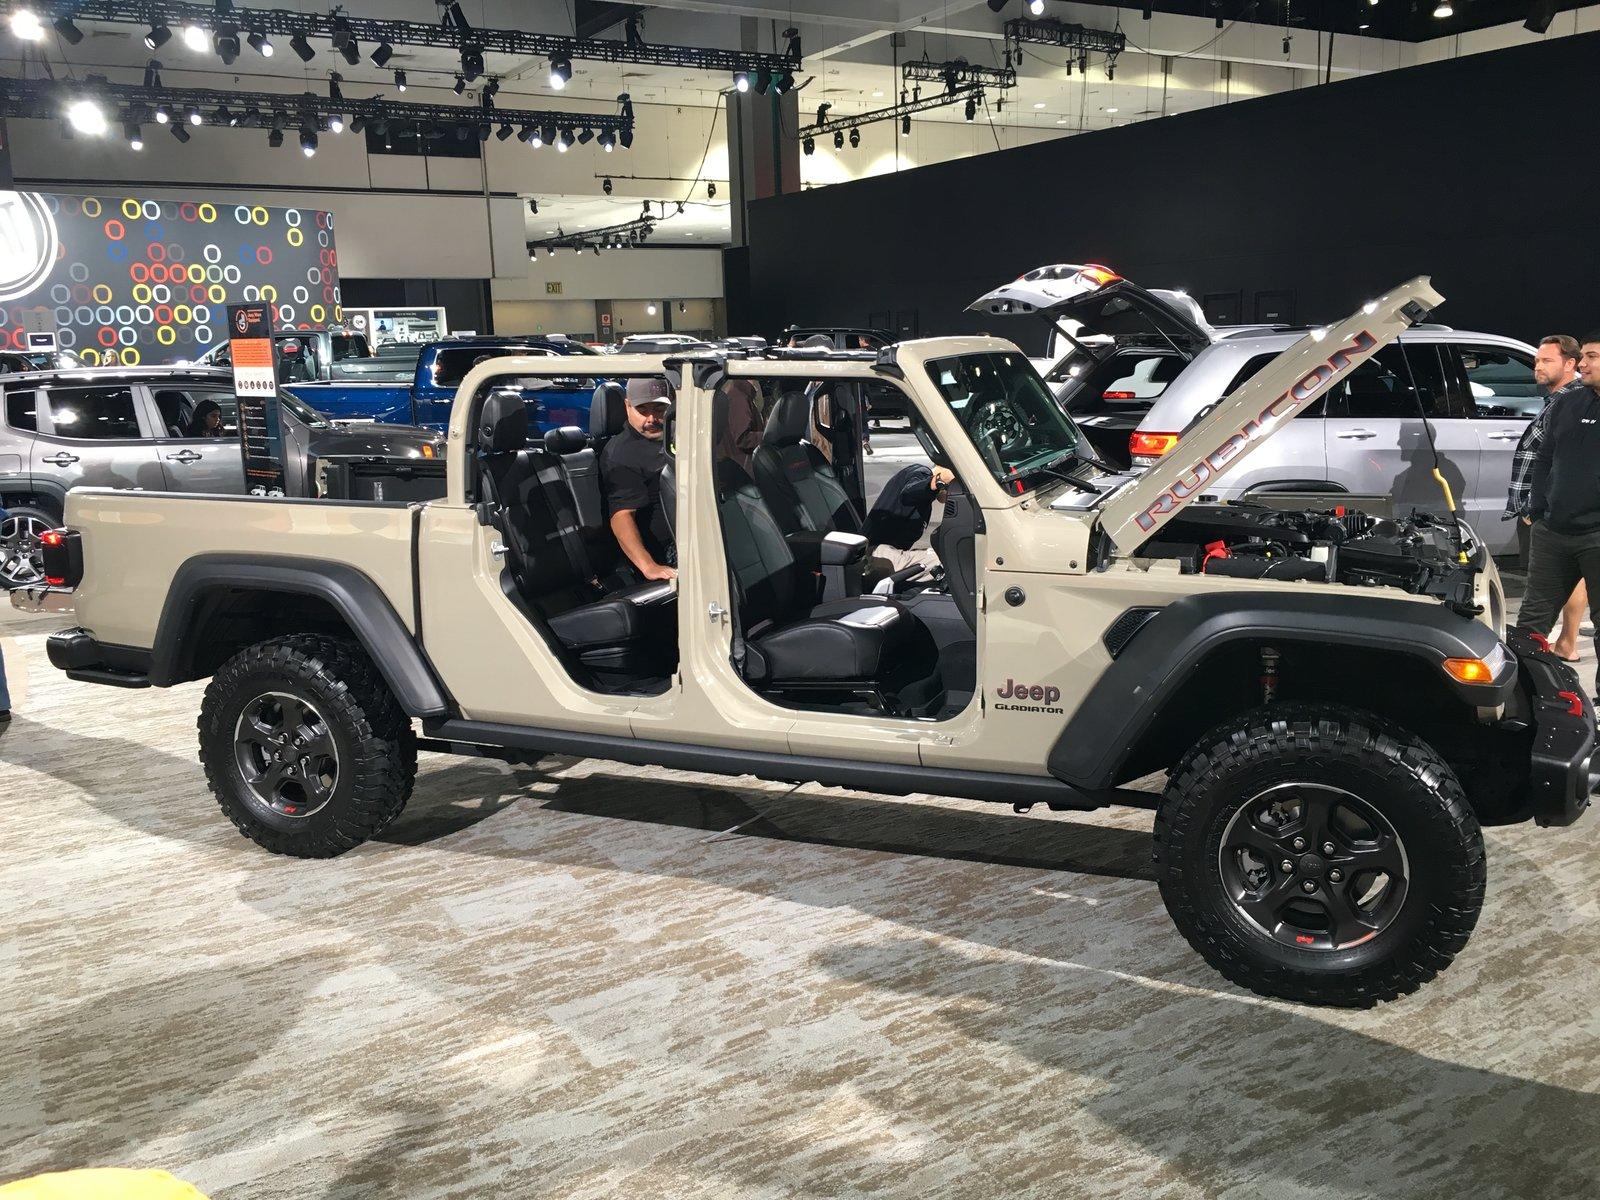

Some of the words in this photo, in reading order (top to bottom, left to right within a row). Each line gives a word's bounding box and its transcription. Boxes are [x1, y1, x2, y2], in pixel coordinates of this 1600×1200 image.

[546, 281, 563, 295] EXIT
[1133, 329, 1377, 532] RUBICON
[996, 678, 1061, 706] Jeep
[994, 703, 1065, 715] GLADIATOR
